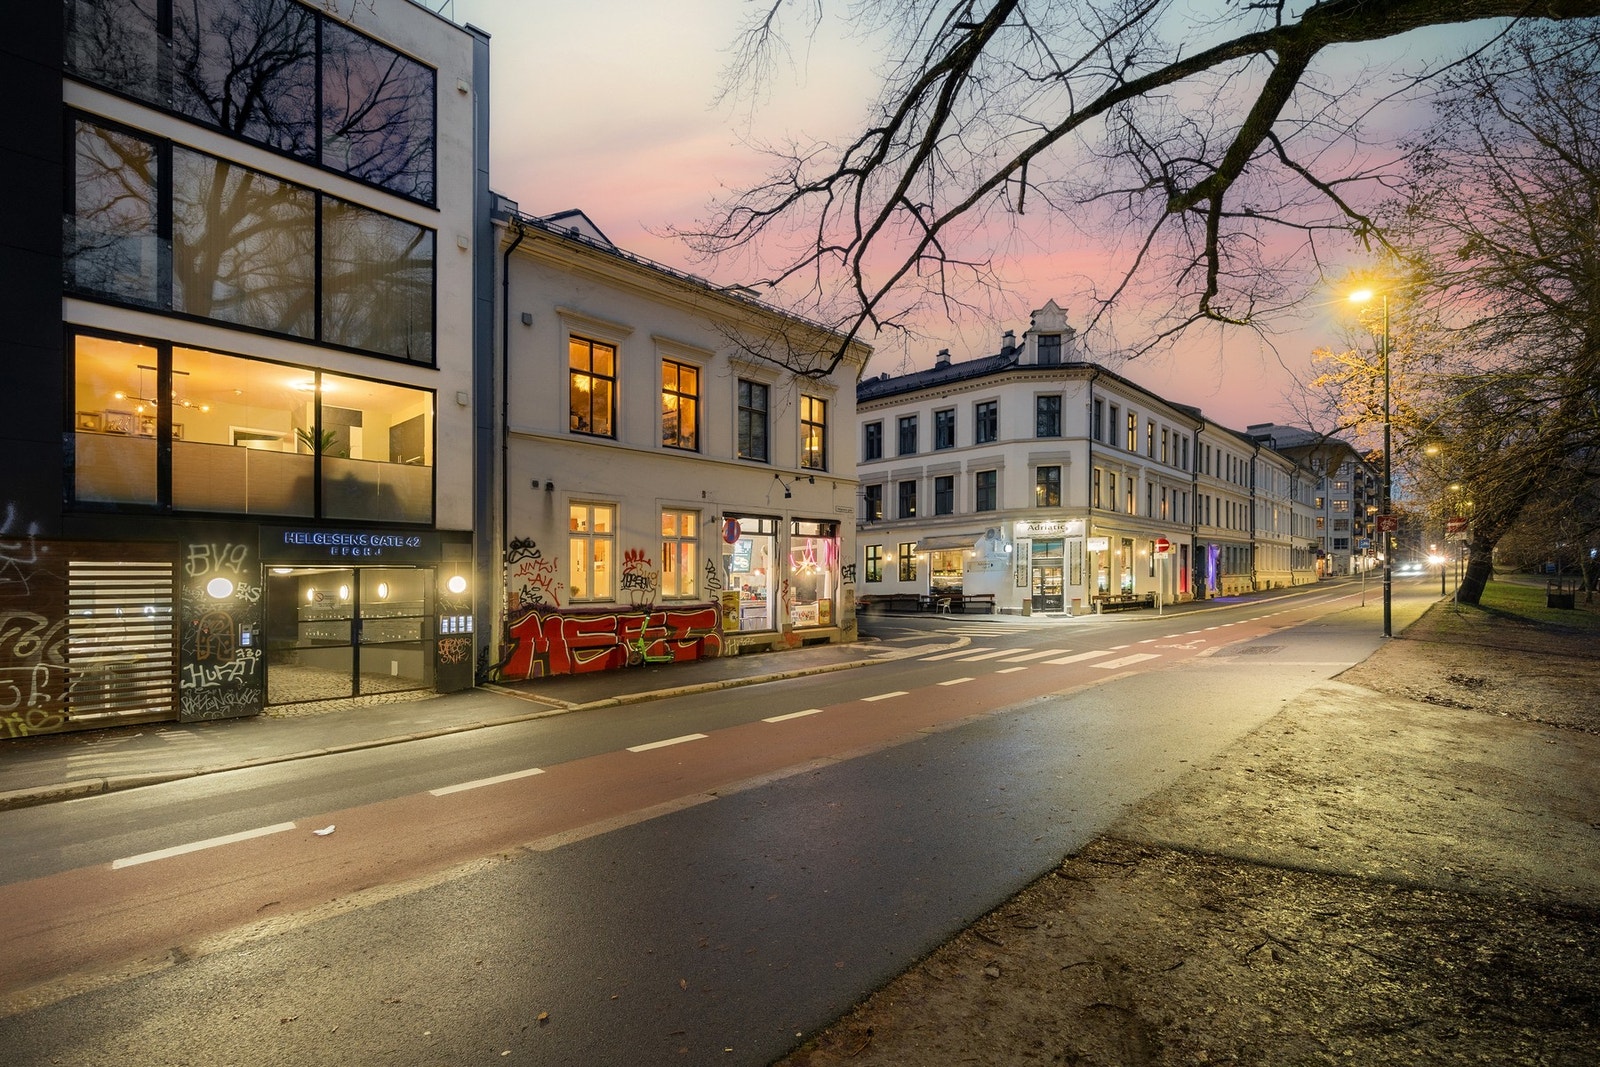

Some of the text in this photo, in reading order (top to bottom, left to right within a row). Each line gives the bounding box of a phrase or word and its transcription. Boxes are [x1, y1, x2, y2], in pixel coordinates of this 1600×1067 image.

[1027, 523, 1066, 531] Adriatic
[284, 531, 422, 548] HELGESENS GATE 42
[342, 546, 350, 556] F
[352, 547, 361, 556] G
